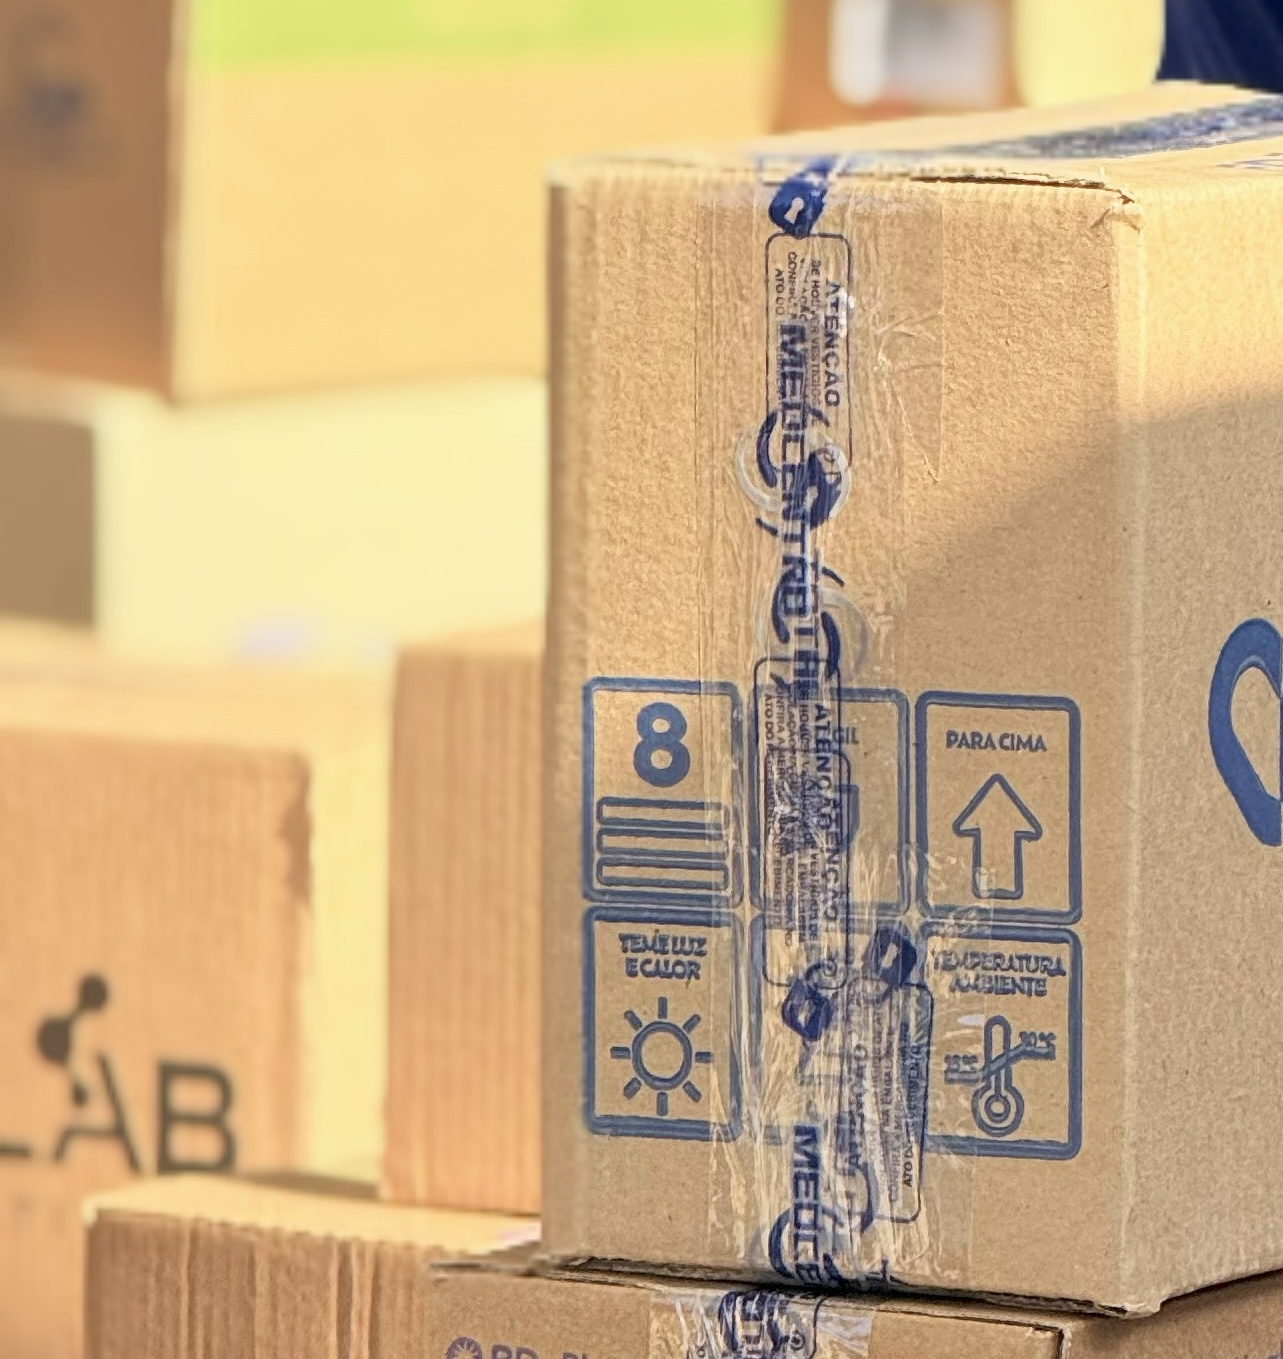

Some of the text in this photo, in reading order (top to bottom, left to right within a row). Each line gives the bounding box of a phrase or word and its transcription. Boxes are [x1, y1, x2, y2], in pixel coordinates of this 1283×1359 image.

[821, 281, 842, 408] ATENÇÃO
[764, 693, 774, 719] ATO
[764, 722, 774, 740] DO
[945, 730, 1047, 752] PARA CIMA
[632, 702, 690, 787] 8
[618, 933, 708, 957] TEME LUZ
[625, 957, 639, 978] E
[0, 1052, 236, 1174] AB
[903, 1161, 913, 1187] ATO
